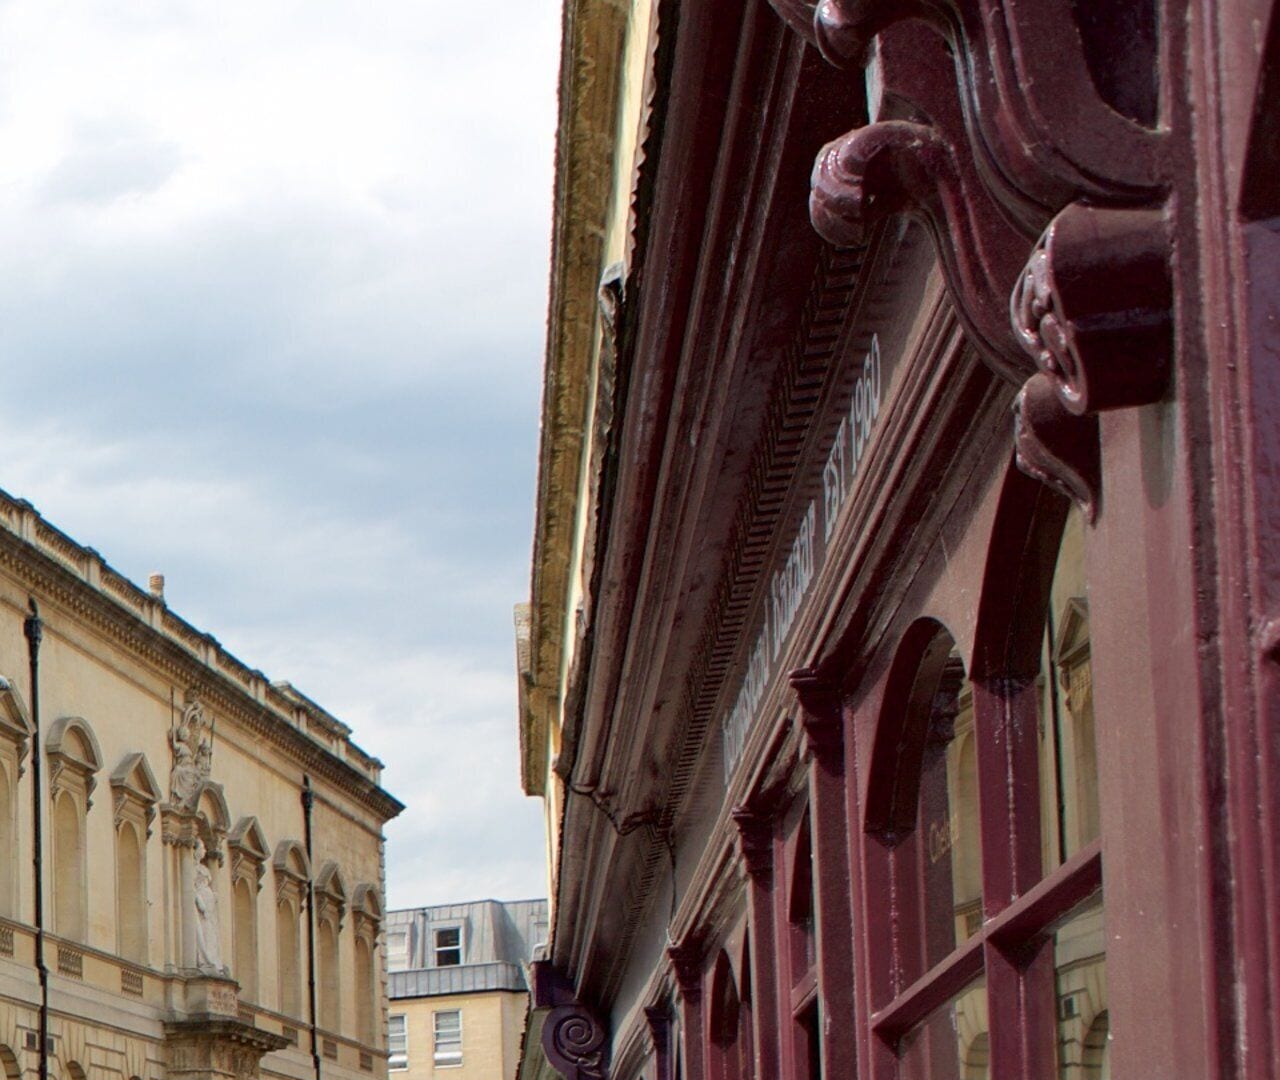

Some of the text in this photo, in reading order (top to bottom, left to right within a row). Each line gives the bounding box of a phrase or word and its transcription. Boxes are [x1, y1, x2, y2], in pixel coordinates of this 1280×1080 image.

[771, 500, 815, 663] bazaar
[823, 416, 846, 545] EST
[850, 332, 880, 475] 1960
